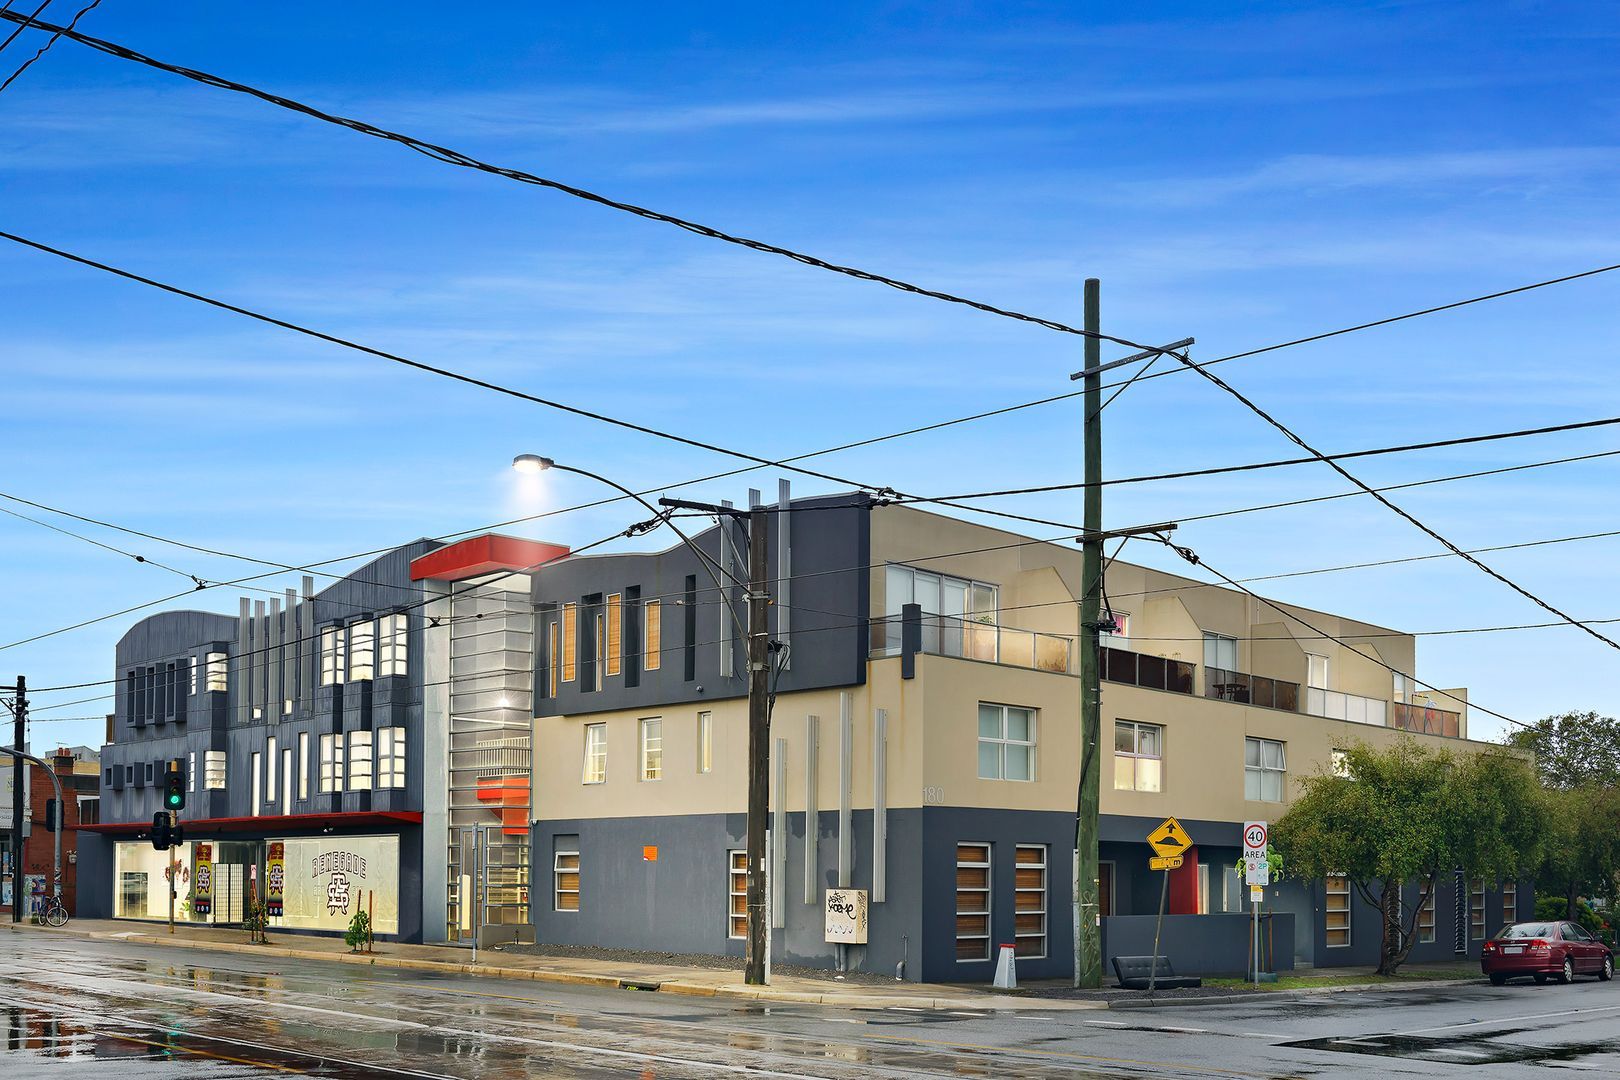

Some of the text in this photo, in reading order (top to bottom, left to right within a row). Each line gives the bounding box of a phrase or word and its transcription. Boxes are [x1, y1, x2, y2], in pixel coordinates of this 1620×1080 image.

[922, 786, 944, 803] 180
[1247, 830, 1264, 842] 40
[1244, 850, 1266, 859] AREA
[311, 851, 367, 880] RENEGADE
[1258, 862, 1268, 870] 2P
